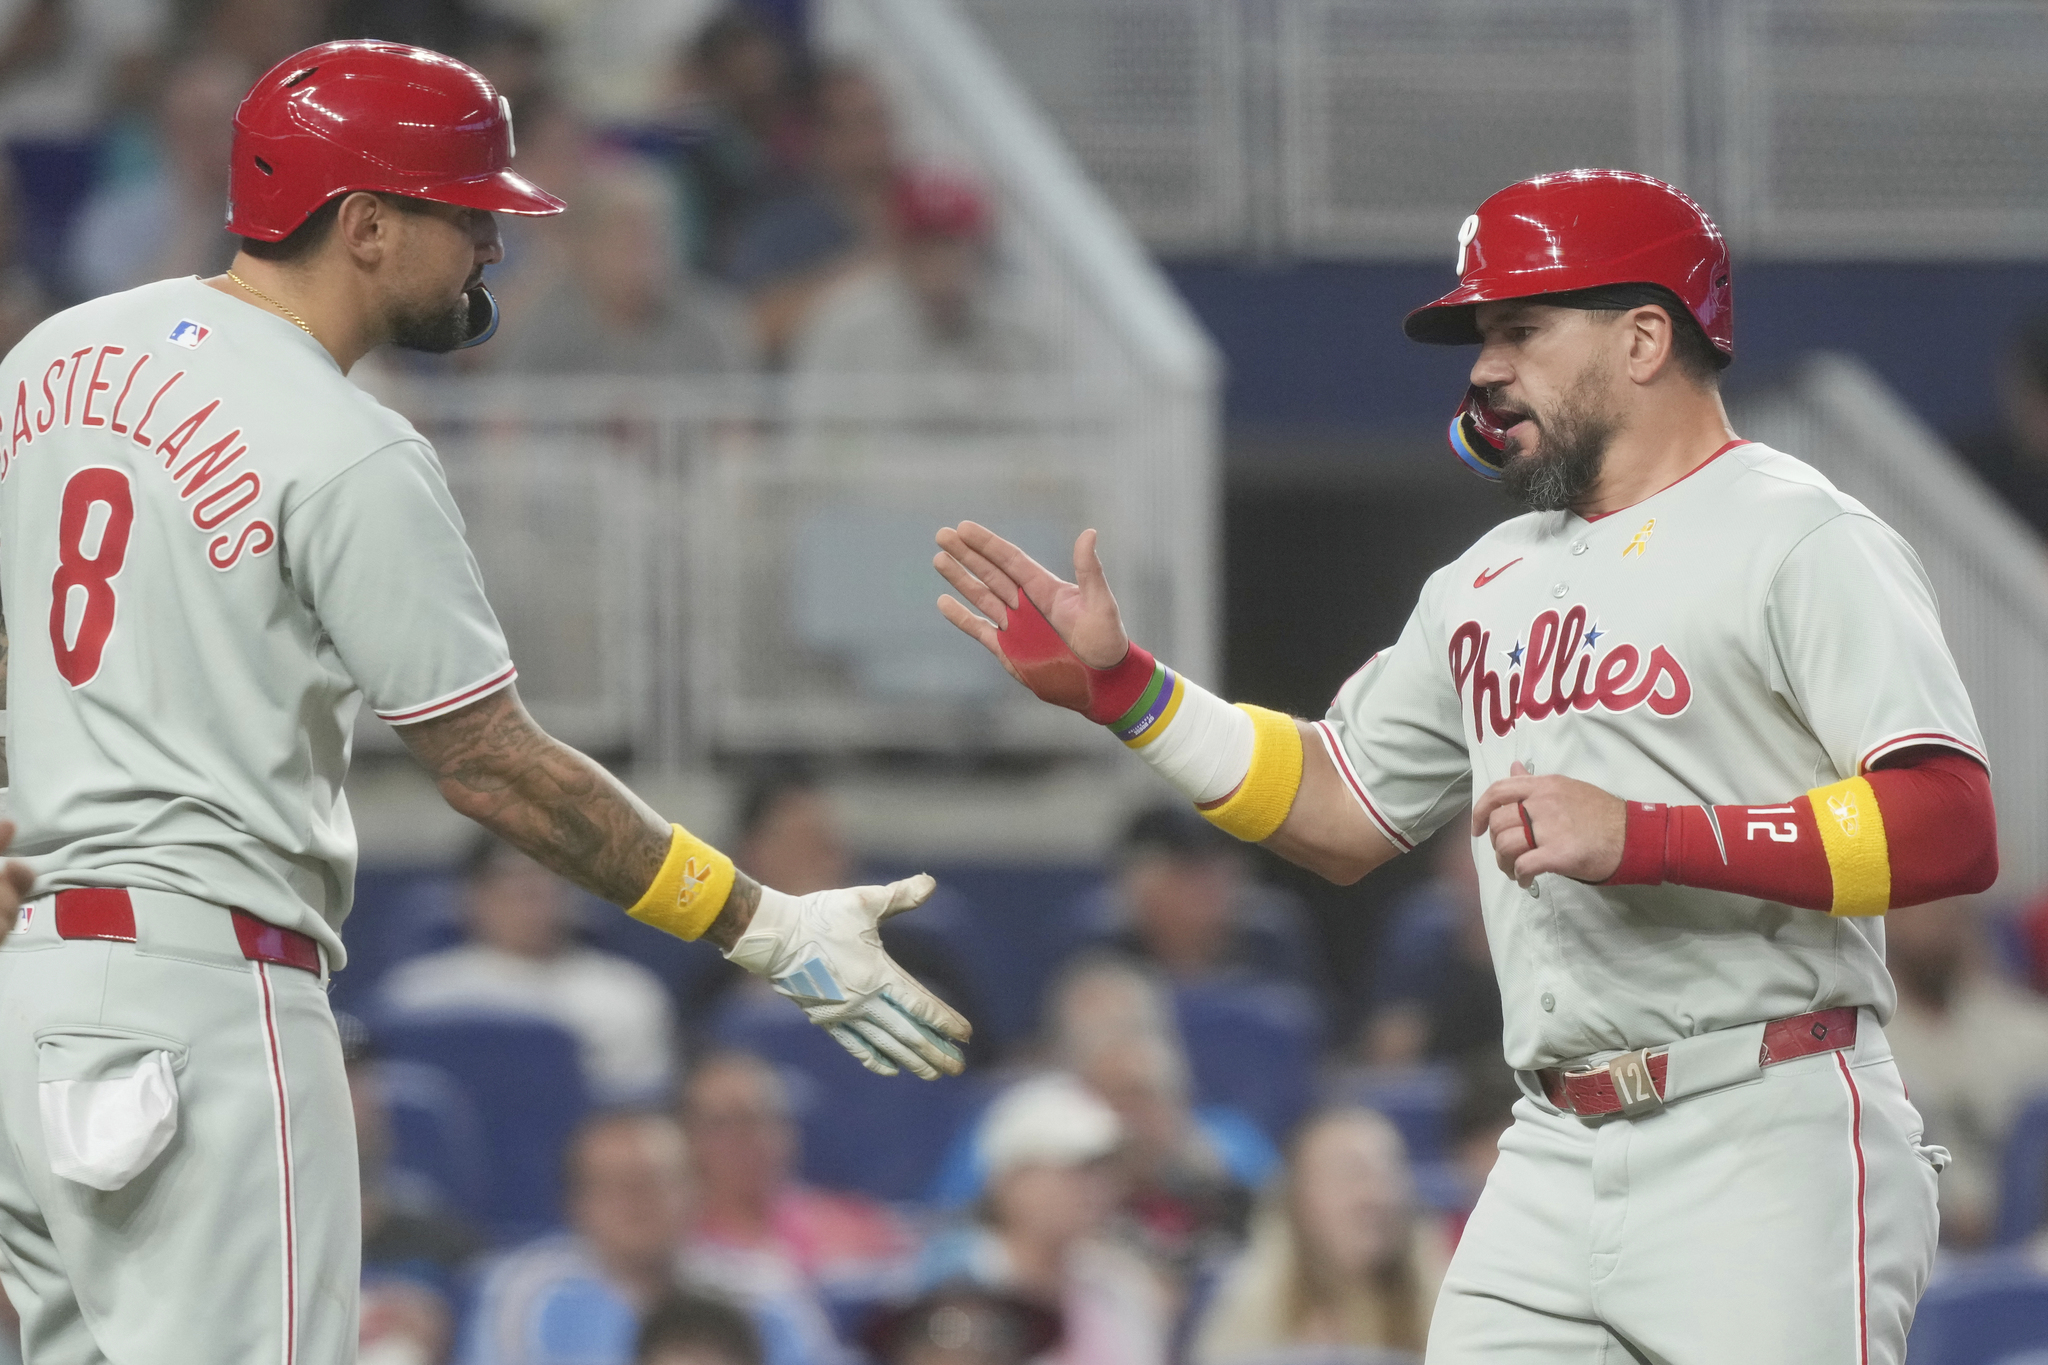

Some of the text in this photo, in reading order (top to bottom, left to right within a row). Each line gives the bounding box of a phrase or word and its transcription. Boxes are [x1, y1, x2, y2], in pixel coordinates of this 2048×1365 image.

[49, 466, 134, 688] 8
[1448, 604, 1693, 745] Phillies
[1747, 805, 1798, 843] 12
[1615, 1062, 1650, 1104] 12
